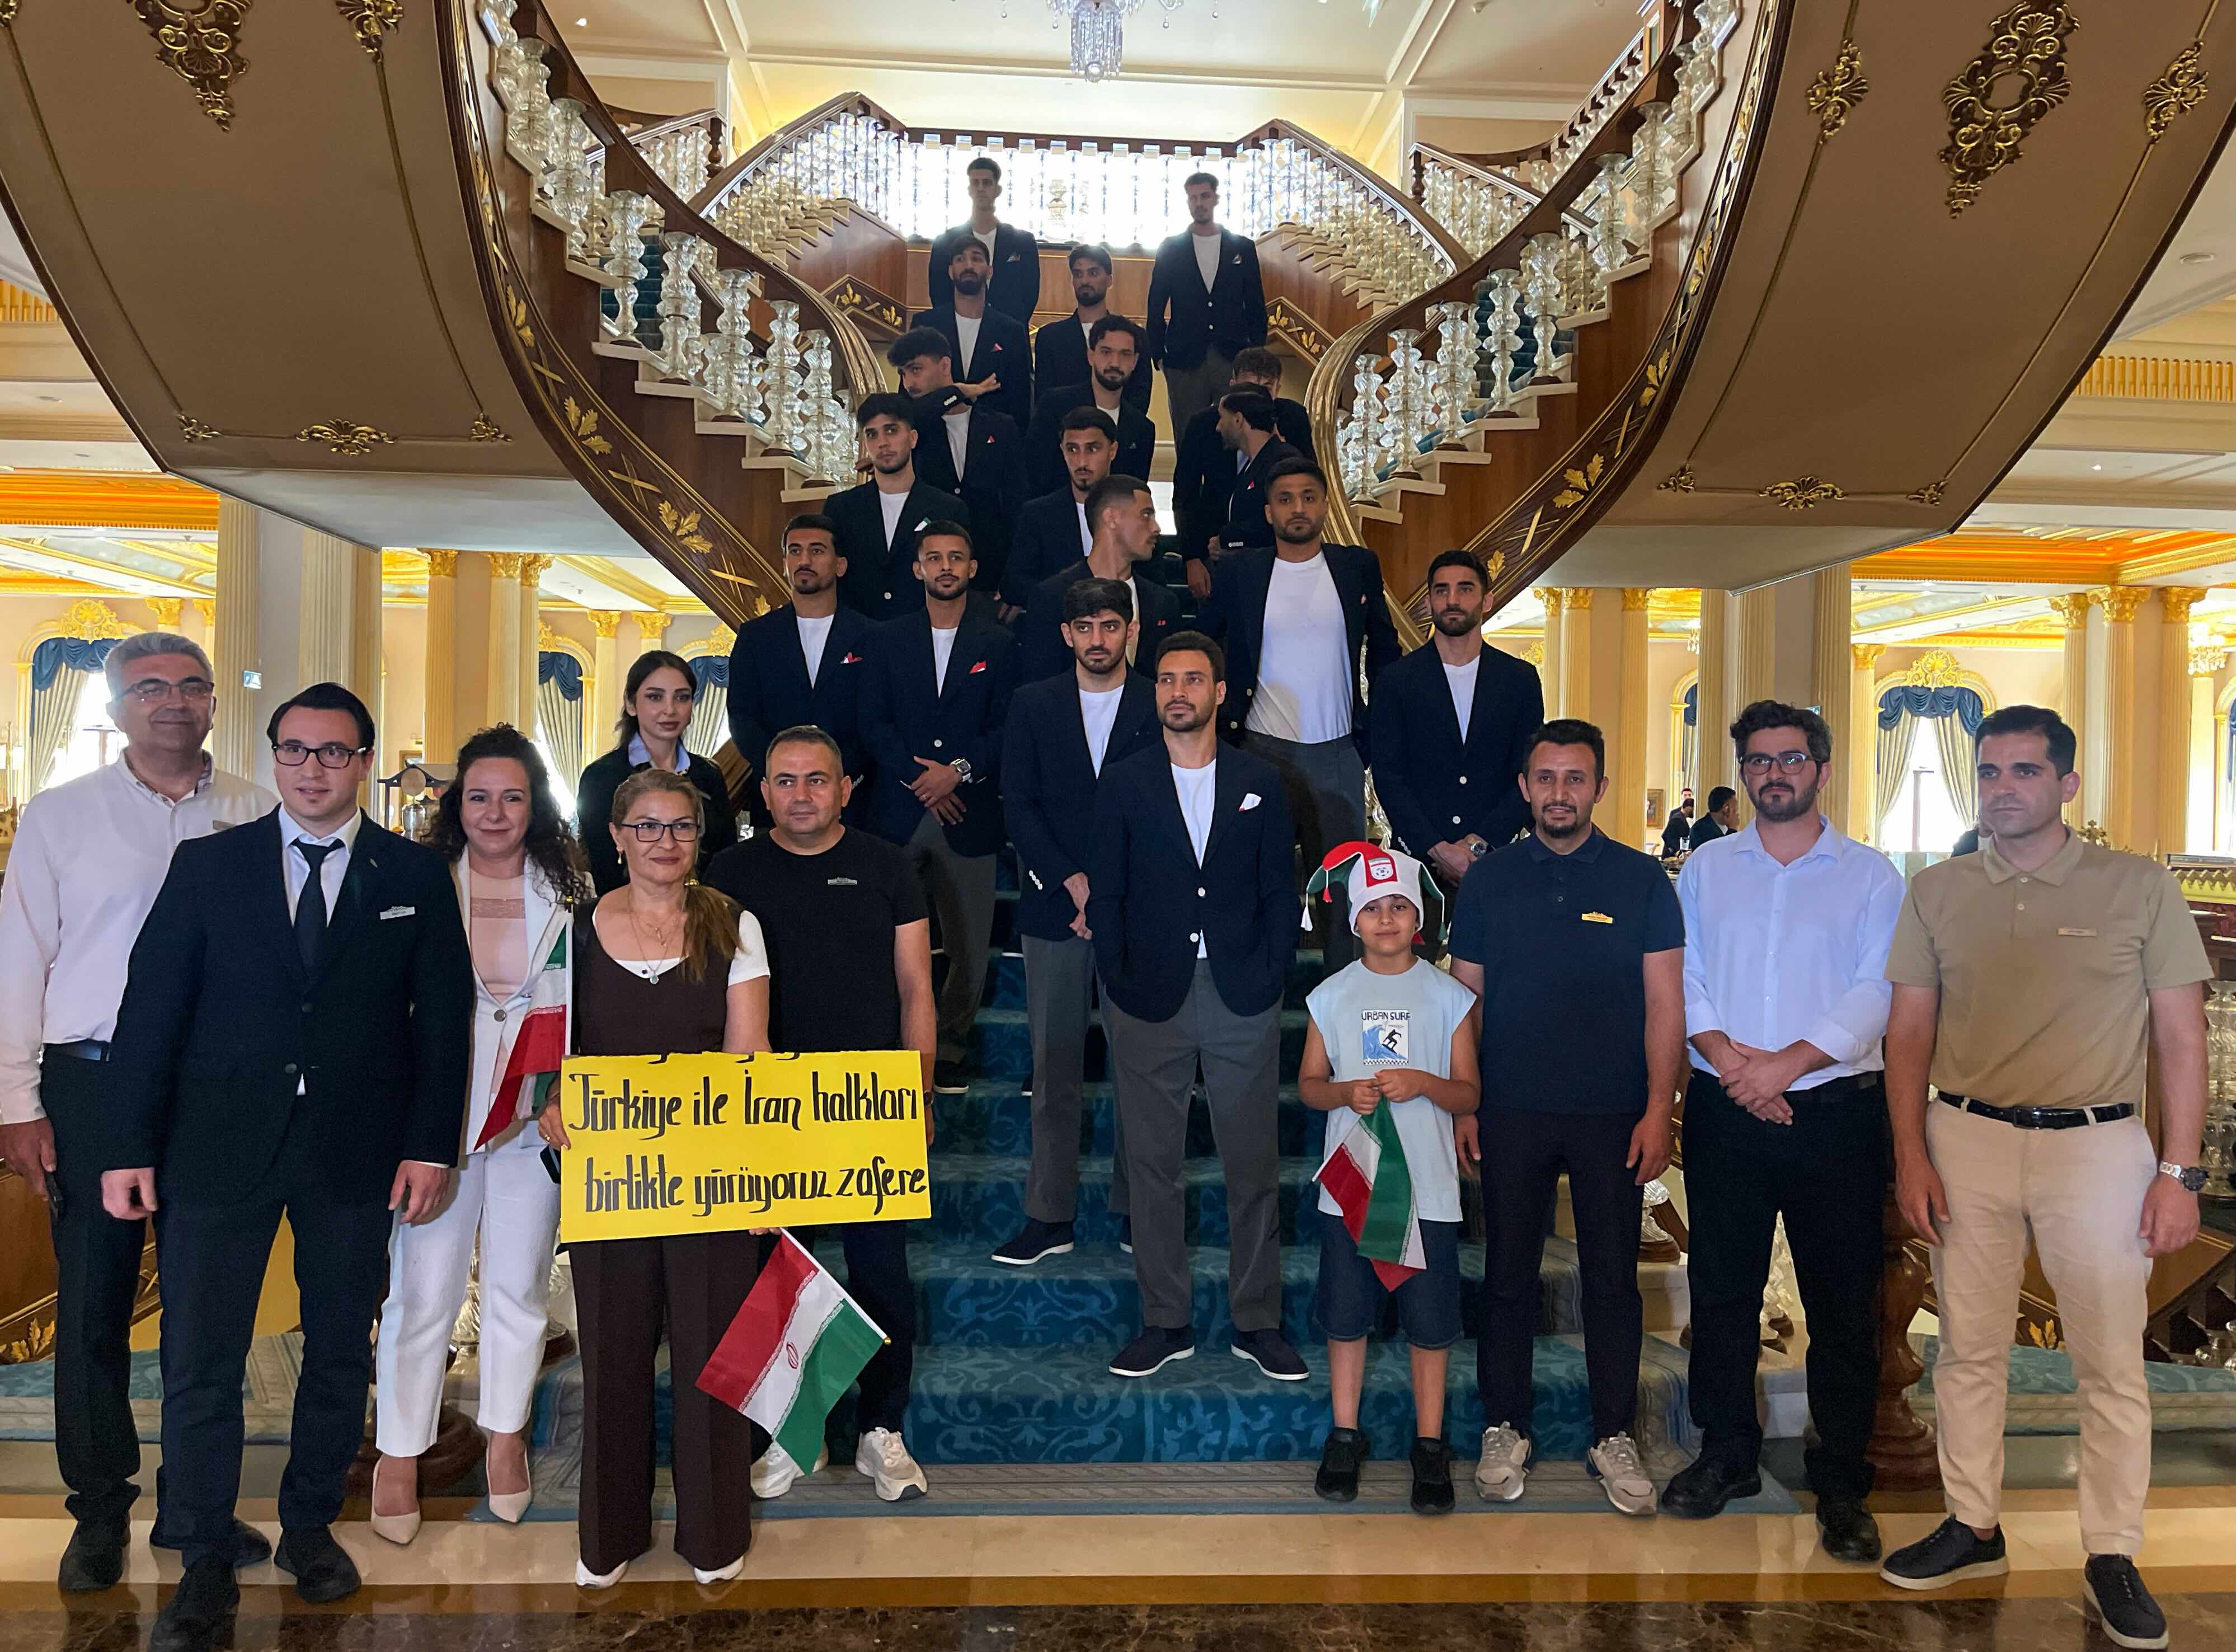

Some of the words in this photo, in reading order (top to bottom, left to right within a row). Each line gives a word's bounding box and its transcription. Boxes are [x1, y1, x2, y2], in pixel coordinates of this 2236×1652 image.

[1361, 1011, 1388, 1020] URBAN
[1390, 1011, 1411, 1020] SURF
[568, 1073, 682, 1141] Türkiye
[693, 1076, 729, 1126] ile
[744, 1069, 801, 1131] İran
[812, 1071, 918, 1123] halkları
[585, 1154, 684, 1212] birlikte
[692, 1166, 833, 1217] yürüyoruz
[835, 1156, 927, 1215] zafere
